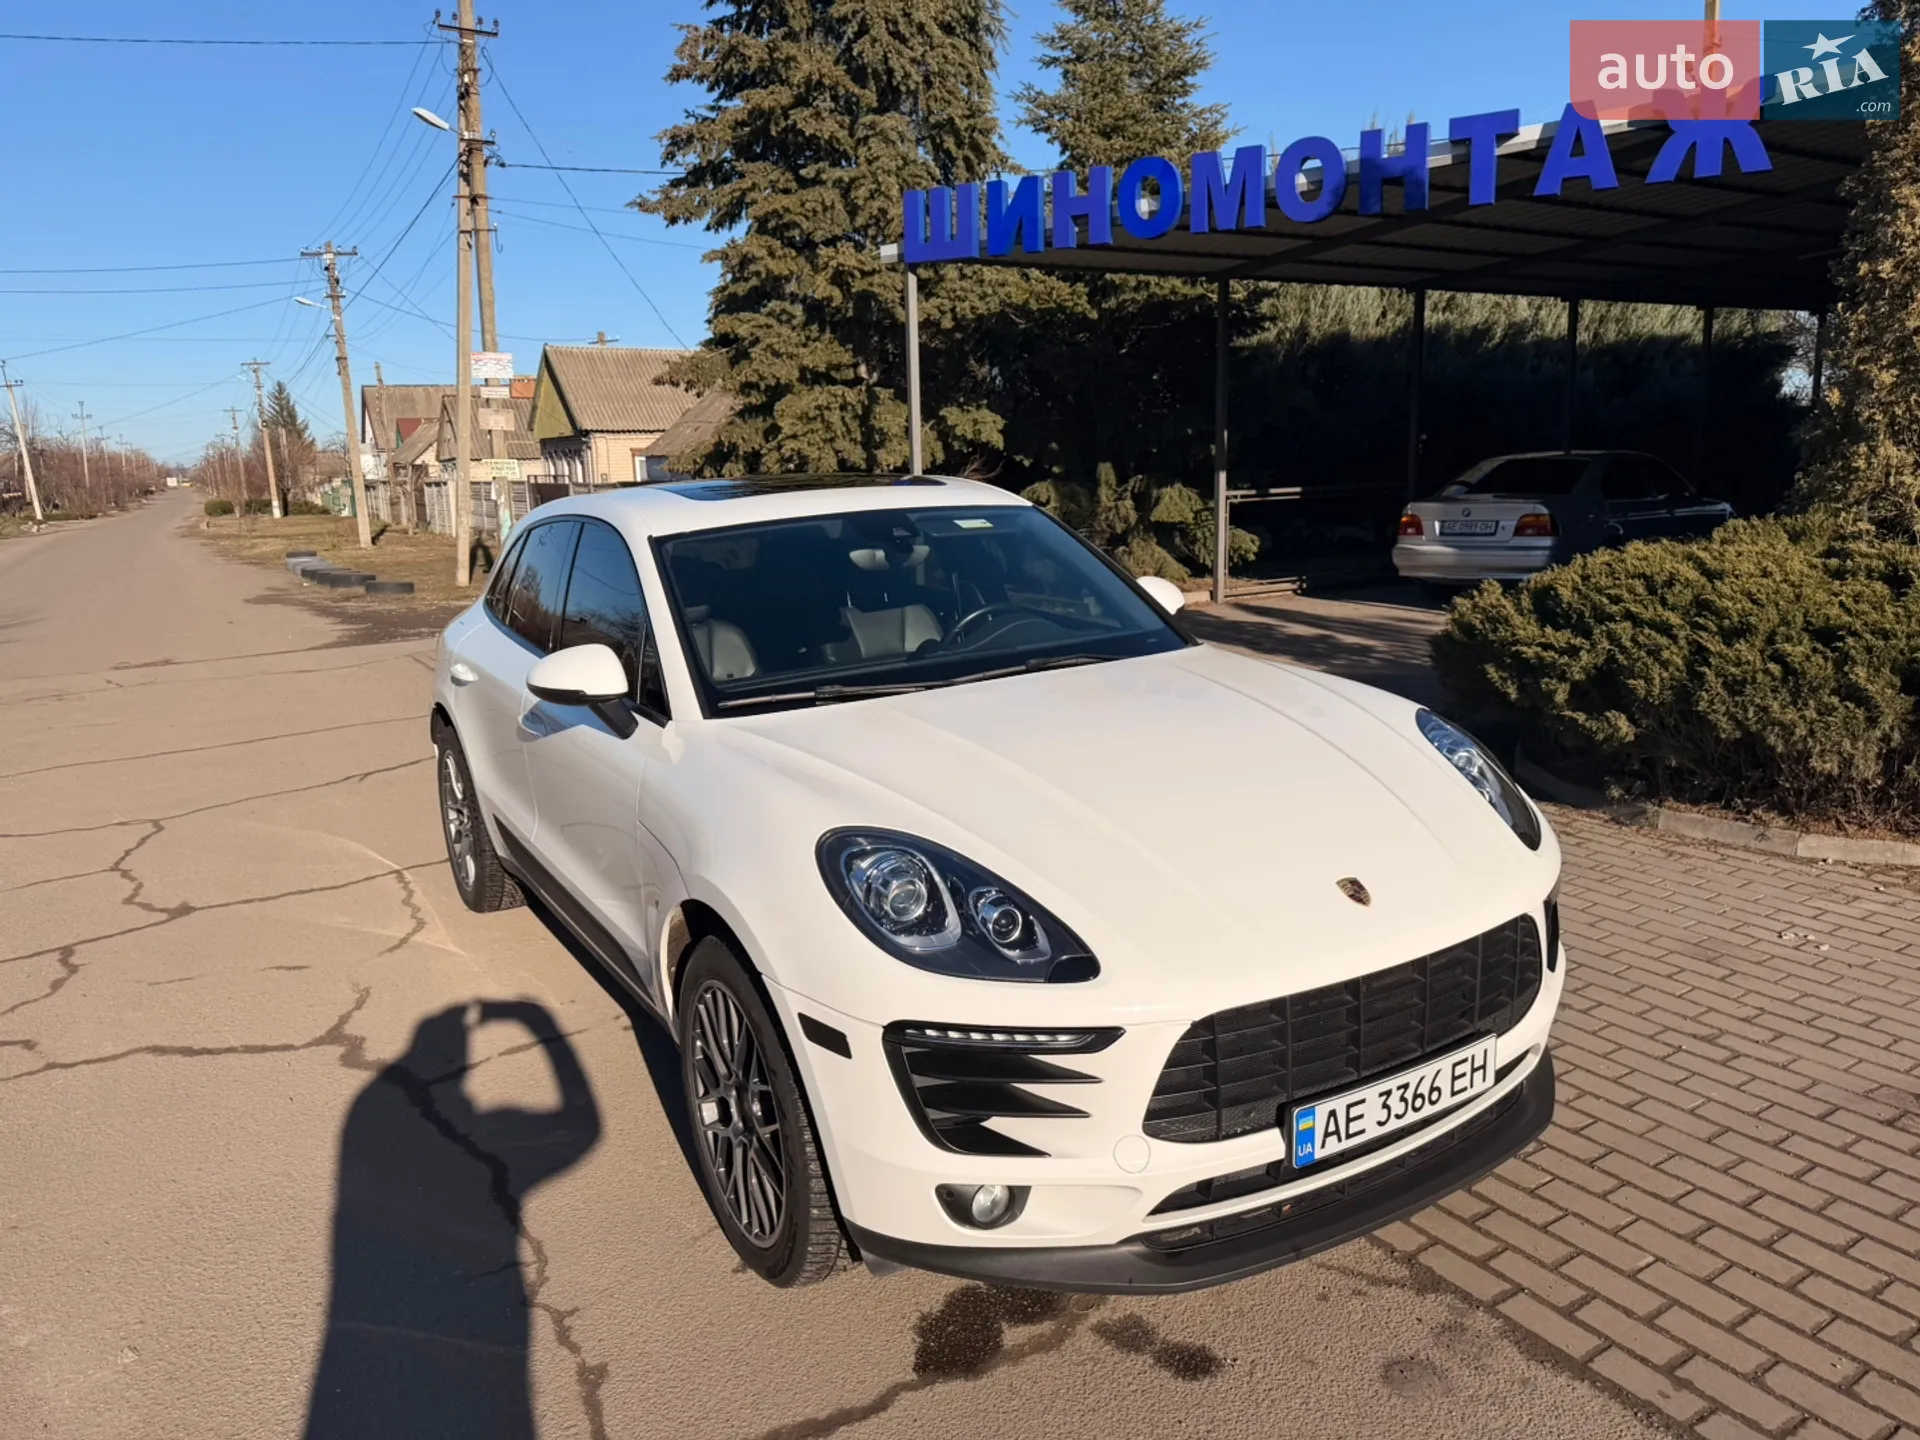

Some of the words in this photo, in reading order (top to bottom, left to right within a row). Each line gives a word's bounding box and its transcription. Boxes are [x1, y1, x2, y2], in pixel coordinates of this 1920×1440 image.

[904, 77, 1777, 263] ШИНОМОНТАЖ
[1298, 1142, 1313, 1156] UA
[1320, 1098, 1366, 1149] AE
[1376, 1069, 1442, 1126] 3366
[1450, 1048, 1488, 1098] EH
